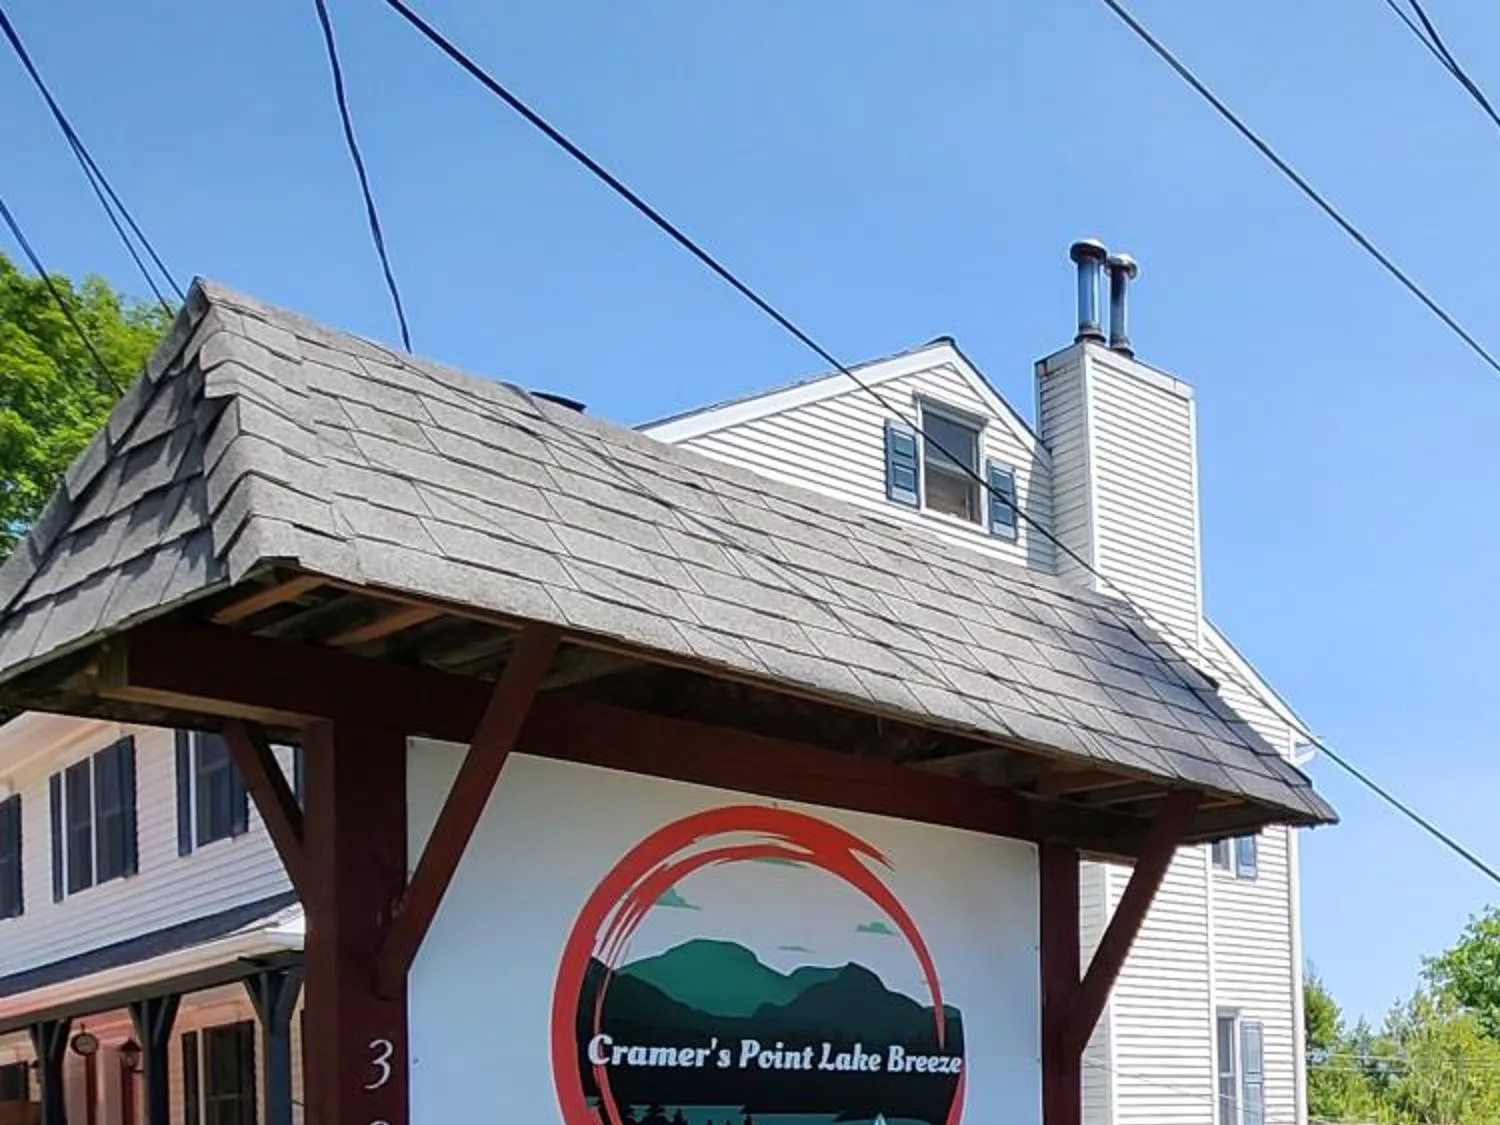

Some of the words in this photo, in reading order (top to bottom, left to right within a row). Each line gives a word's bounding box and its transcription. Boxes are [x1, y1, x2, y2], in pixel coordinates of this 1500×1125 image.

[587, 1033, 731, 1068] Cramer's
[738, 1039, 813, 1071] Point
[818, 1042, 881, 1072] Lake
[887, 1045, 963, 1074] Breeze
